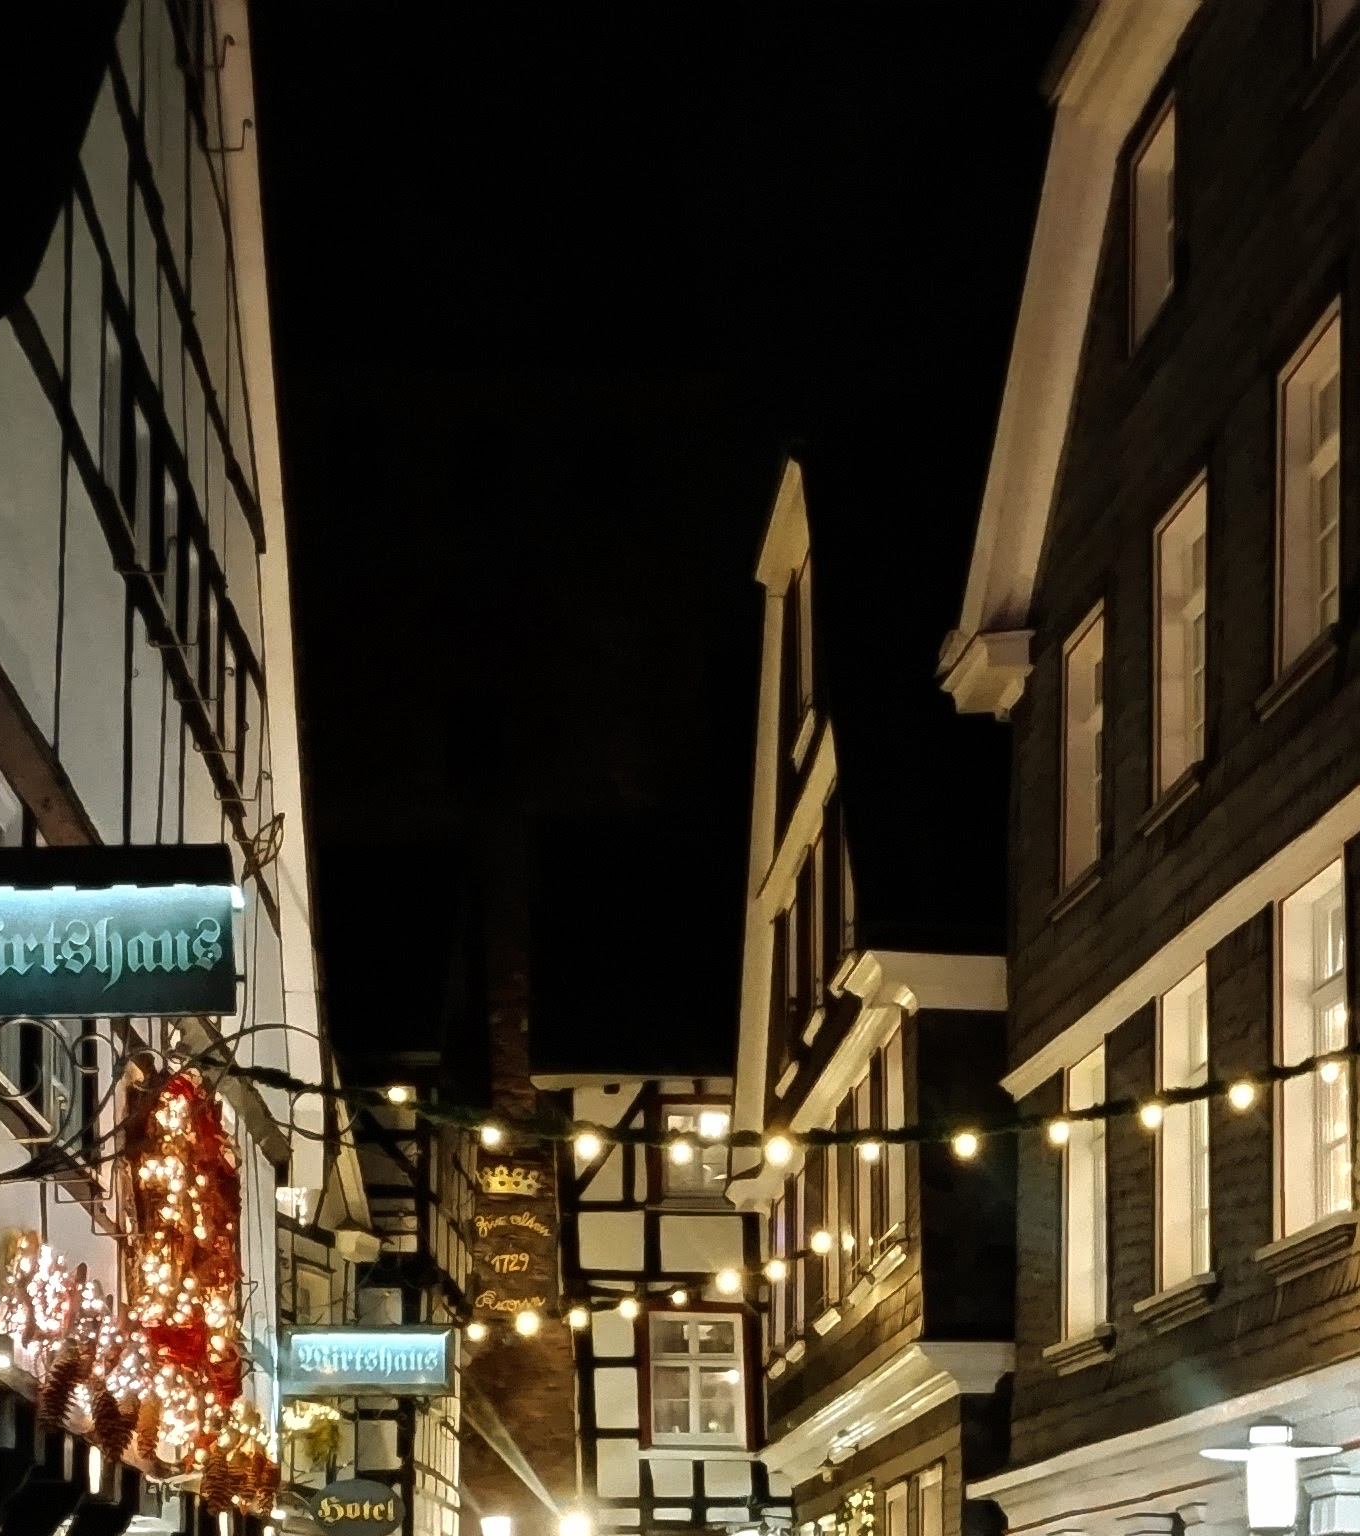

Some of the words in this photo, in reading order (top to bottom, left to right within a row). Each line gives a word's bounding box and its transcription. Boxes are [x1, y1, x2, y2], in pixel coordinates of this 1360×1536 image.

[491, 1253, 530, 1273] 1729
[298, 1344, 438, 1377] Wirtshaus
[318, 1496, 395, 1523] Hotel
